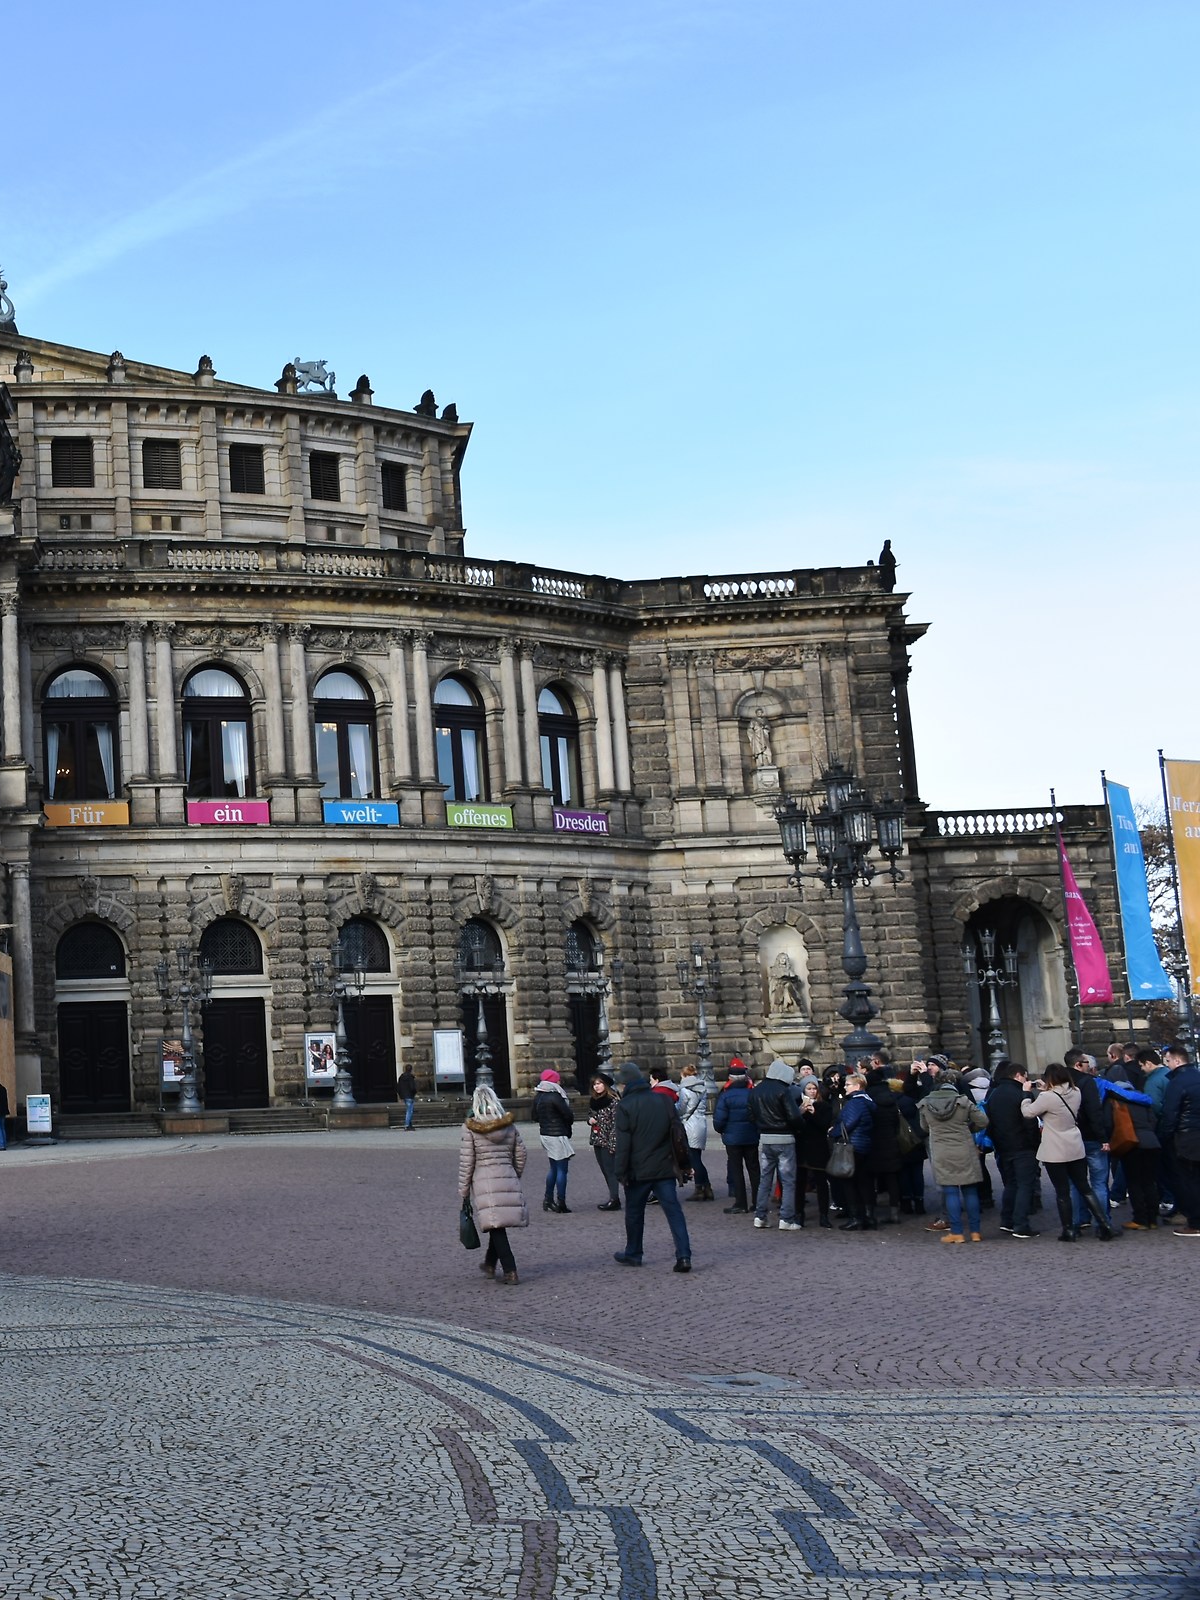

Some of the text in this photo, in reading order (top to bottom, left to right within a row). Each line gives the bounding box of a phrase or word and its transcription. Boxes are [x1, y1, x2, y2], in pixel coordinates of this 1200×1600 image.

[69, 806, 104, 824] Für
[214, 805, 243, 822] ein
[341, 805, 382, 823] welt-
[454, 809, 507, 826] offenes
[555, 813, 607, 832] Dresden
